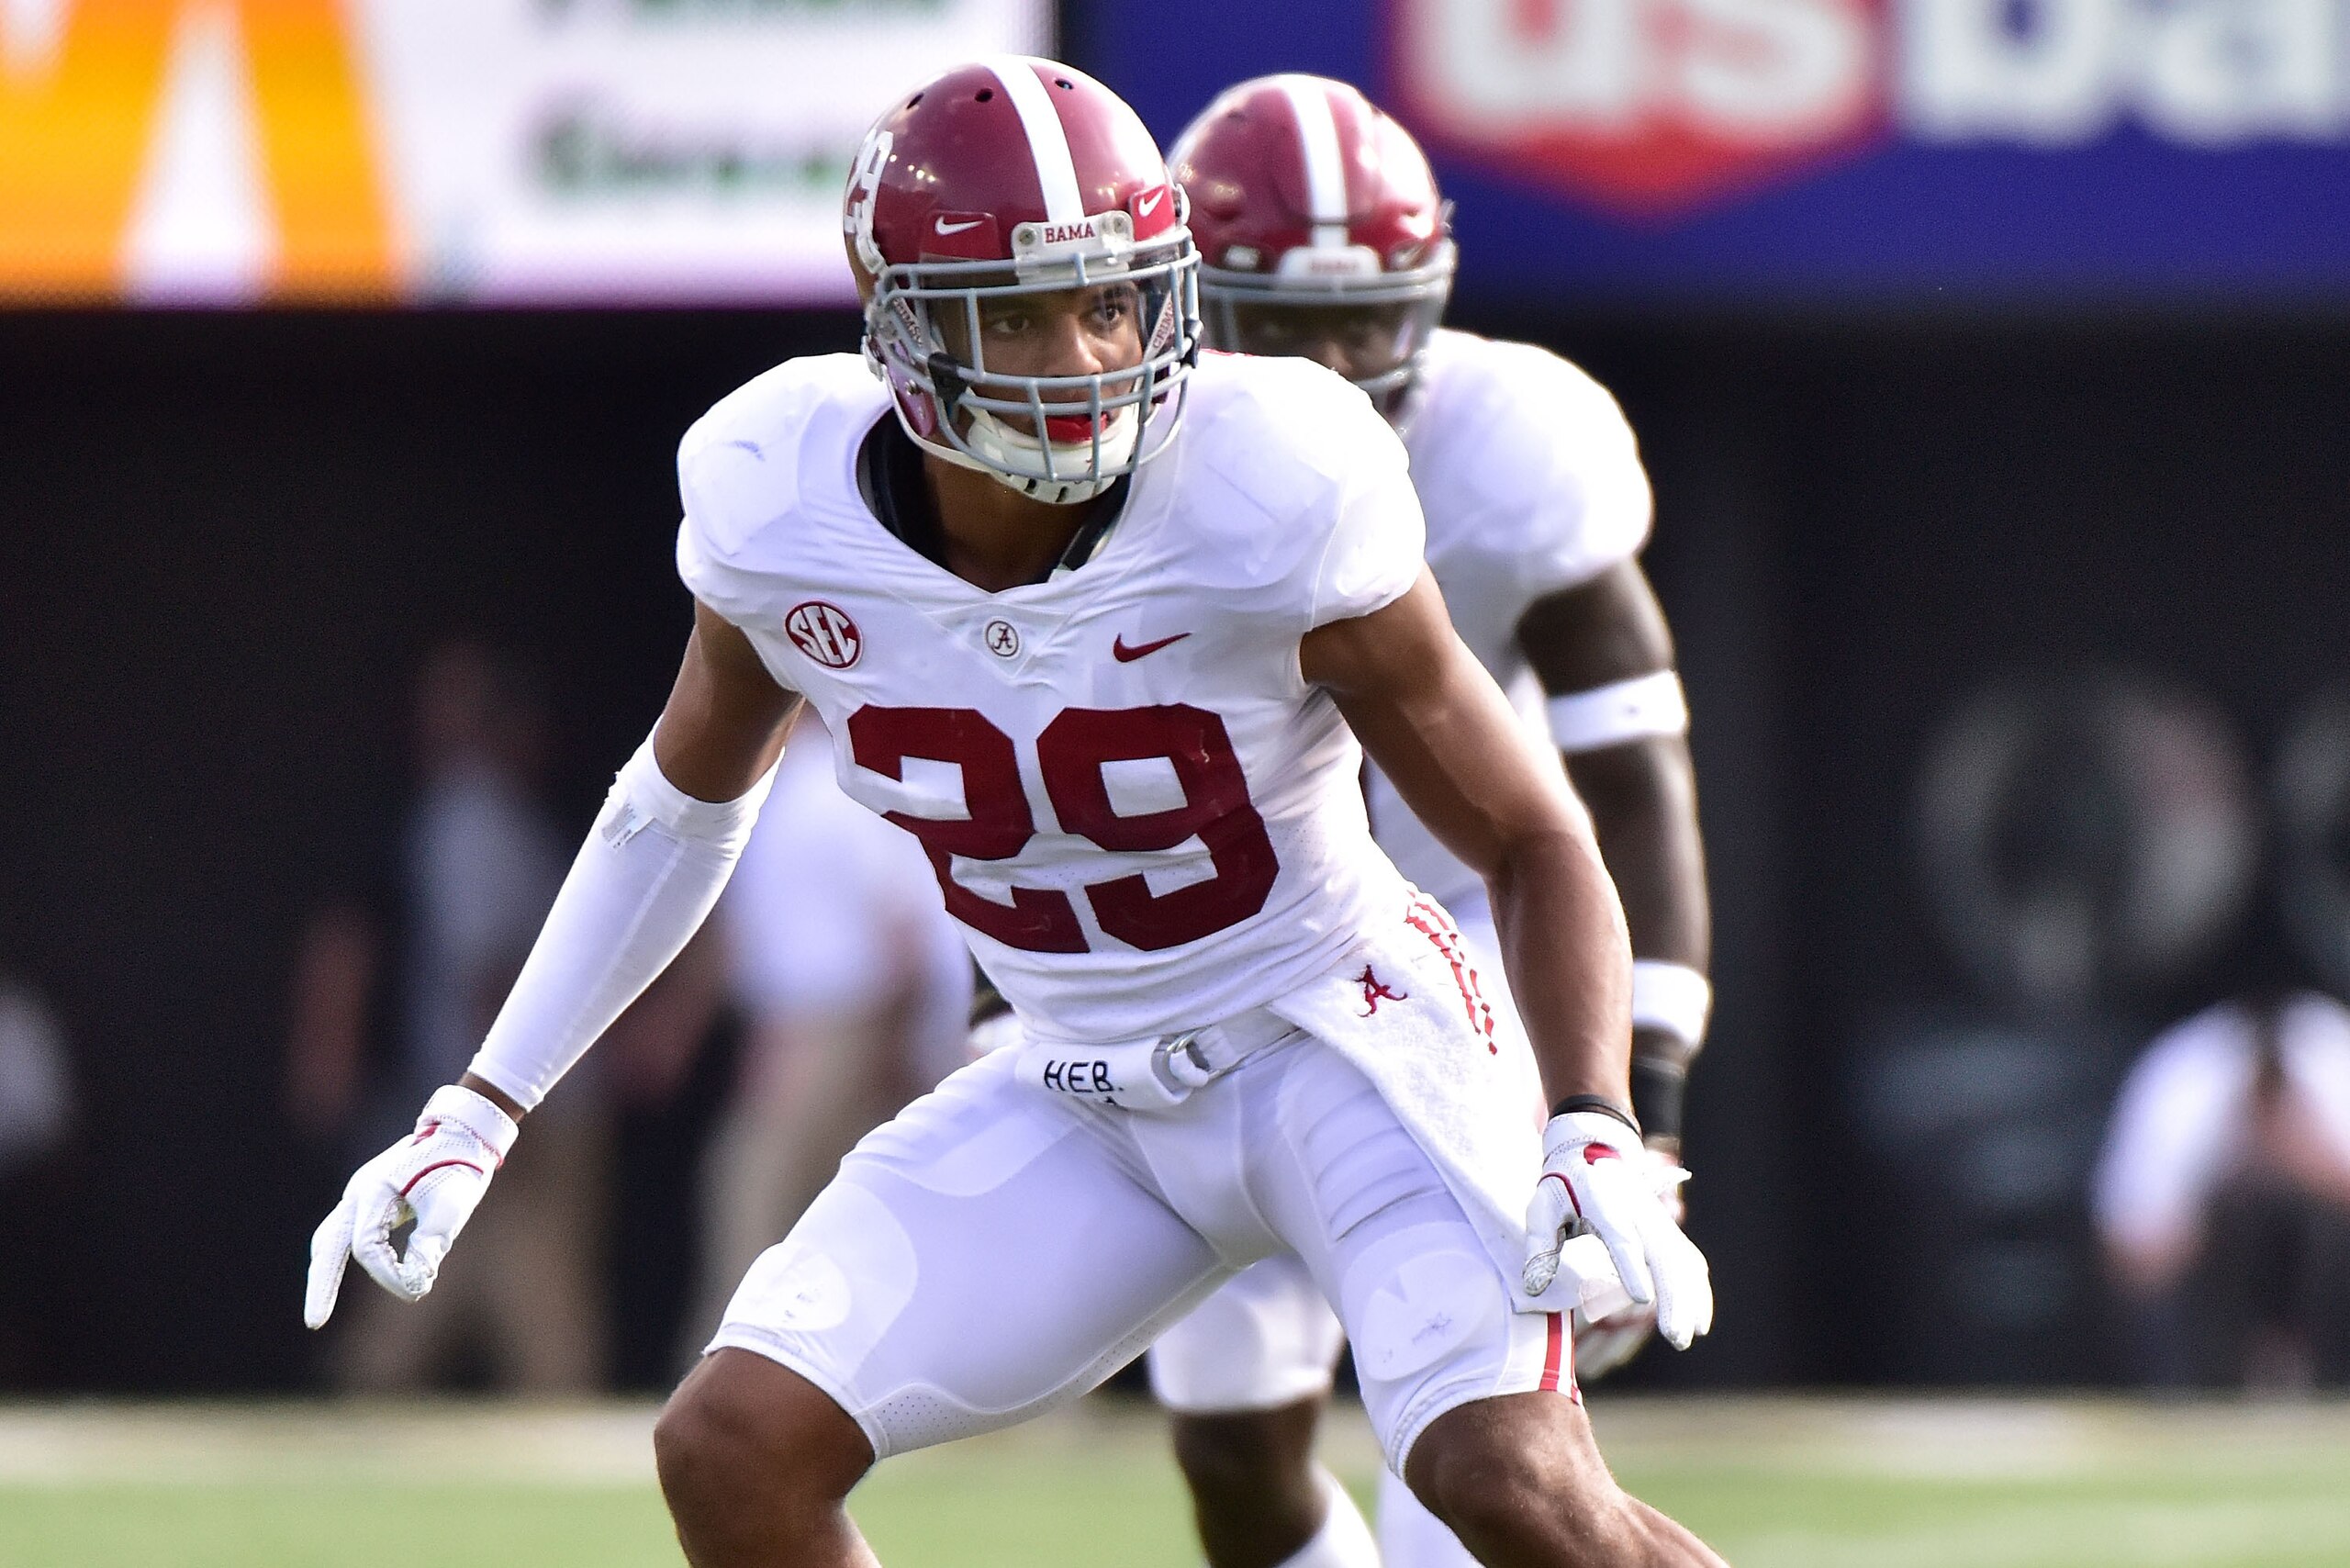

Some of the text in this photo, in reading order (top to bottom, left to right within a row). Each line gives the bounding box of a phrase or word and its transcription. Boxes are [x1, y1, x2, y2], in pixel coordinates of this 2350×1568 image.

[1044, 221, 1096, 244] BAMA
[789, 605, 857, 664] SEC
[846, 702, 1281, 954] 29
